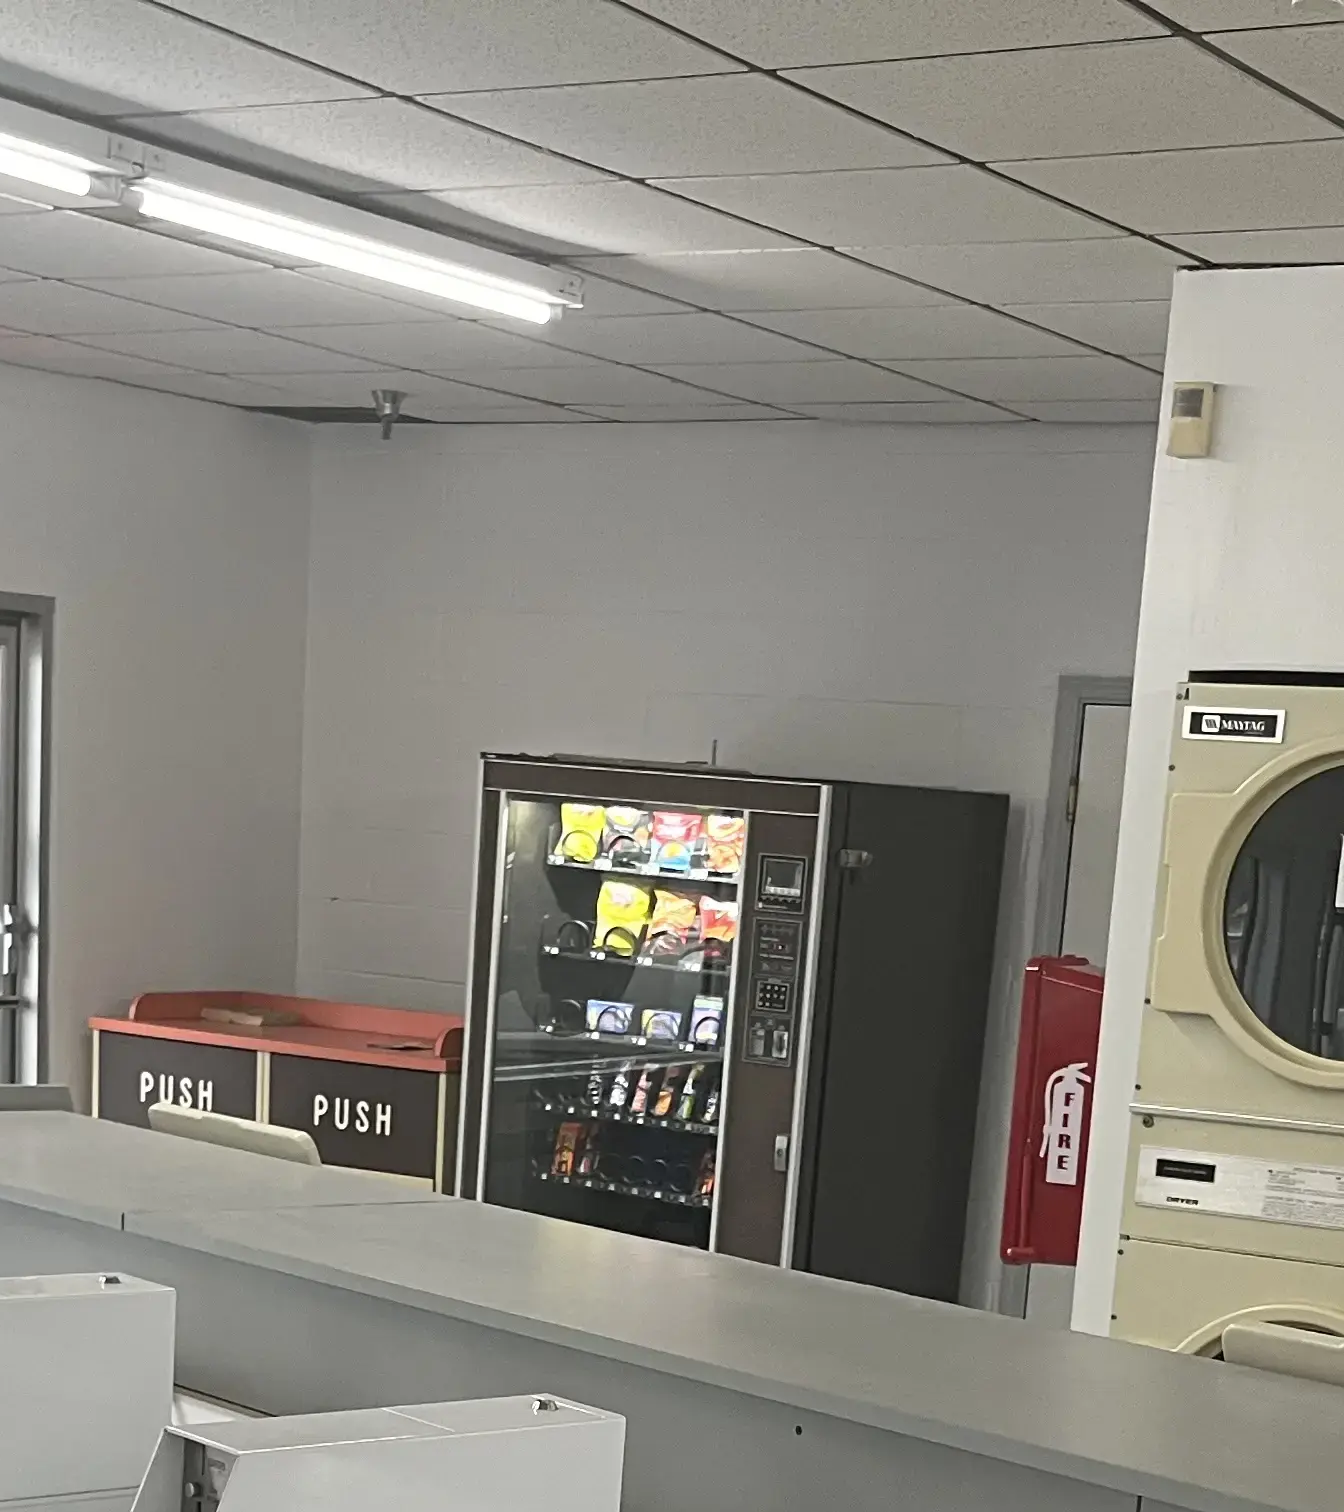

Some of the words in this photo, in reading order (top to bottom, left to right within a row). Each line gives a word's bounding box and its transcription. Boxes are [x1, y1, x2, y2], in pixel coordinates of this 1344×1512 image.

[1221, 718, 1266, 732] MAYTAG
[139, 1071, 213, 1112] PUSH
[313, 1094, 392, 1137] PUSH
[1057, 1091, 1076, 1171] FIRE
